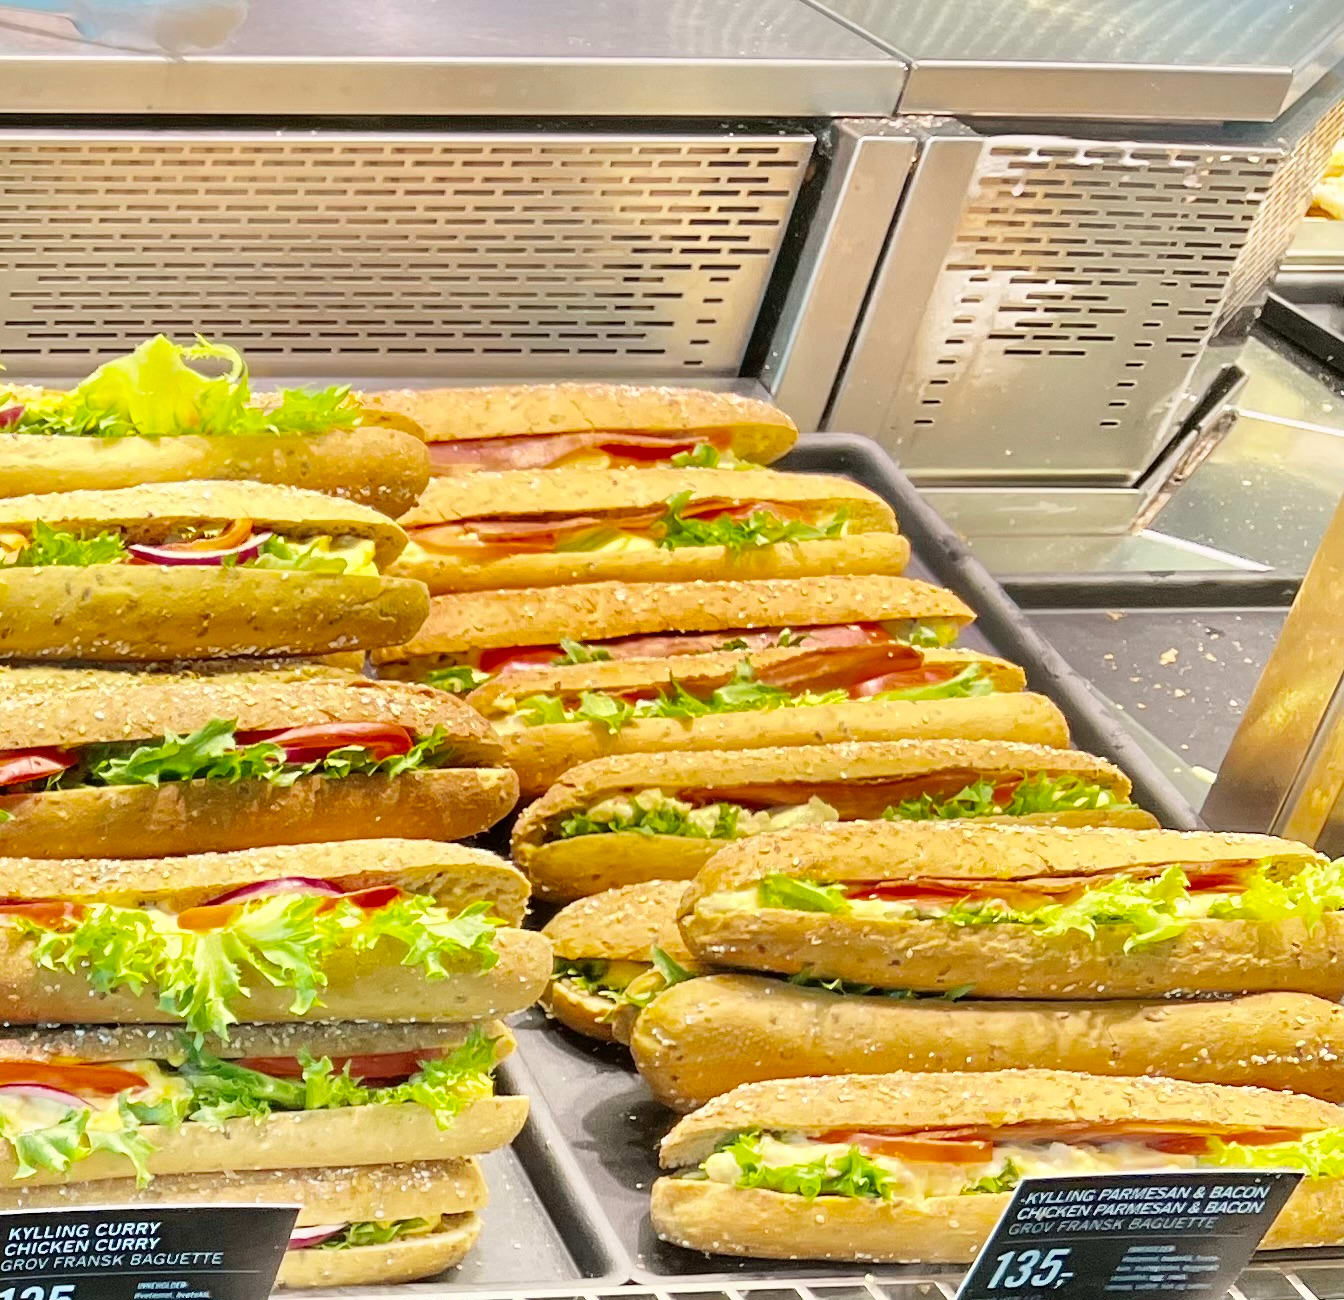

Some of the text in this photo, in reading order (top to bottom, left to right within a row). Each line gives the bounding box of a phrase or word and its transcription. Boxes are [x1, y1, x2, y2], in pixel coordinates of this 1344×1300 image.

[1025, 1186, 1271, 1205] KYLLING PARMESAN & BACON
[1017, 1201, 1266, 1221] CHICKEN PARMESAN & BACON
[8, 1221, 163, 1241] KYLLING CURRY
[1008, 1216, 1219, 1236] GROV FRANSK BAGUETTE
[4, 1237, 162, 1257] CHICKEN CURRY
[0, 1251, 225, 1273] GROV FRANSK BAGUETTE
